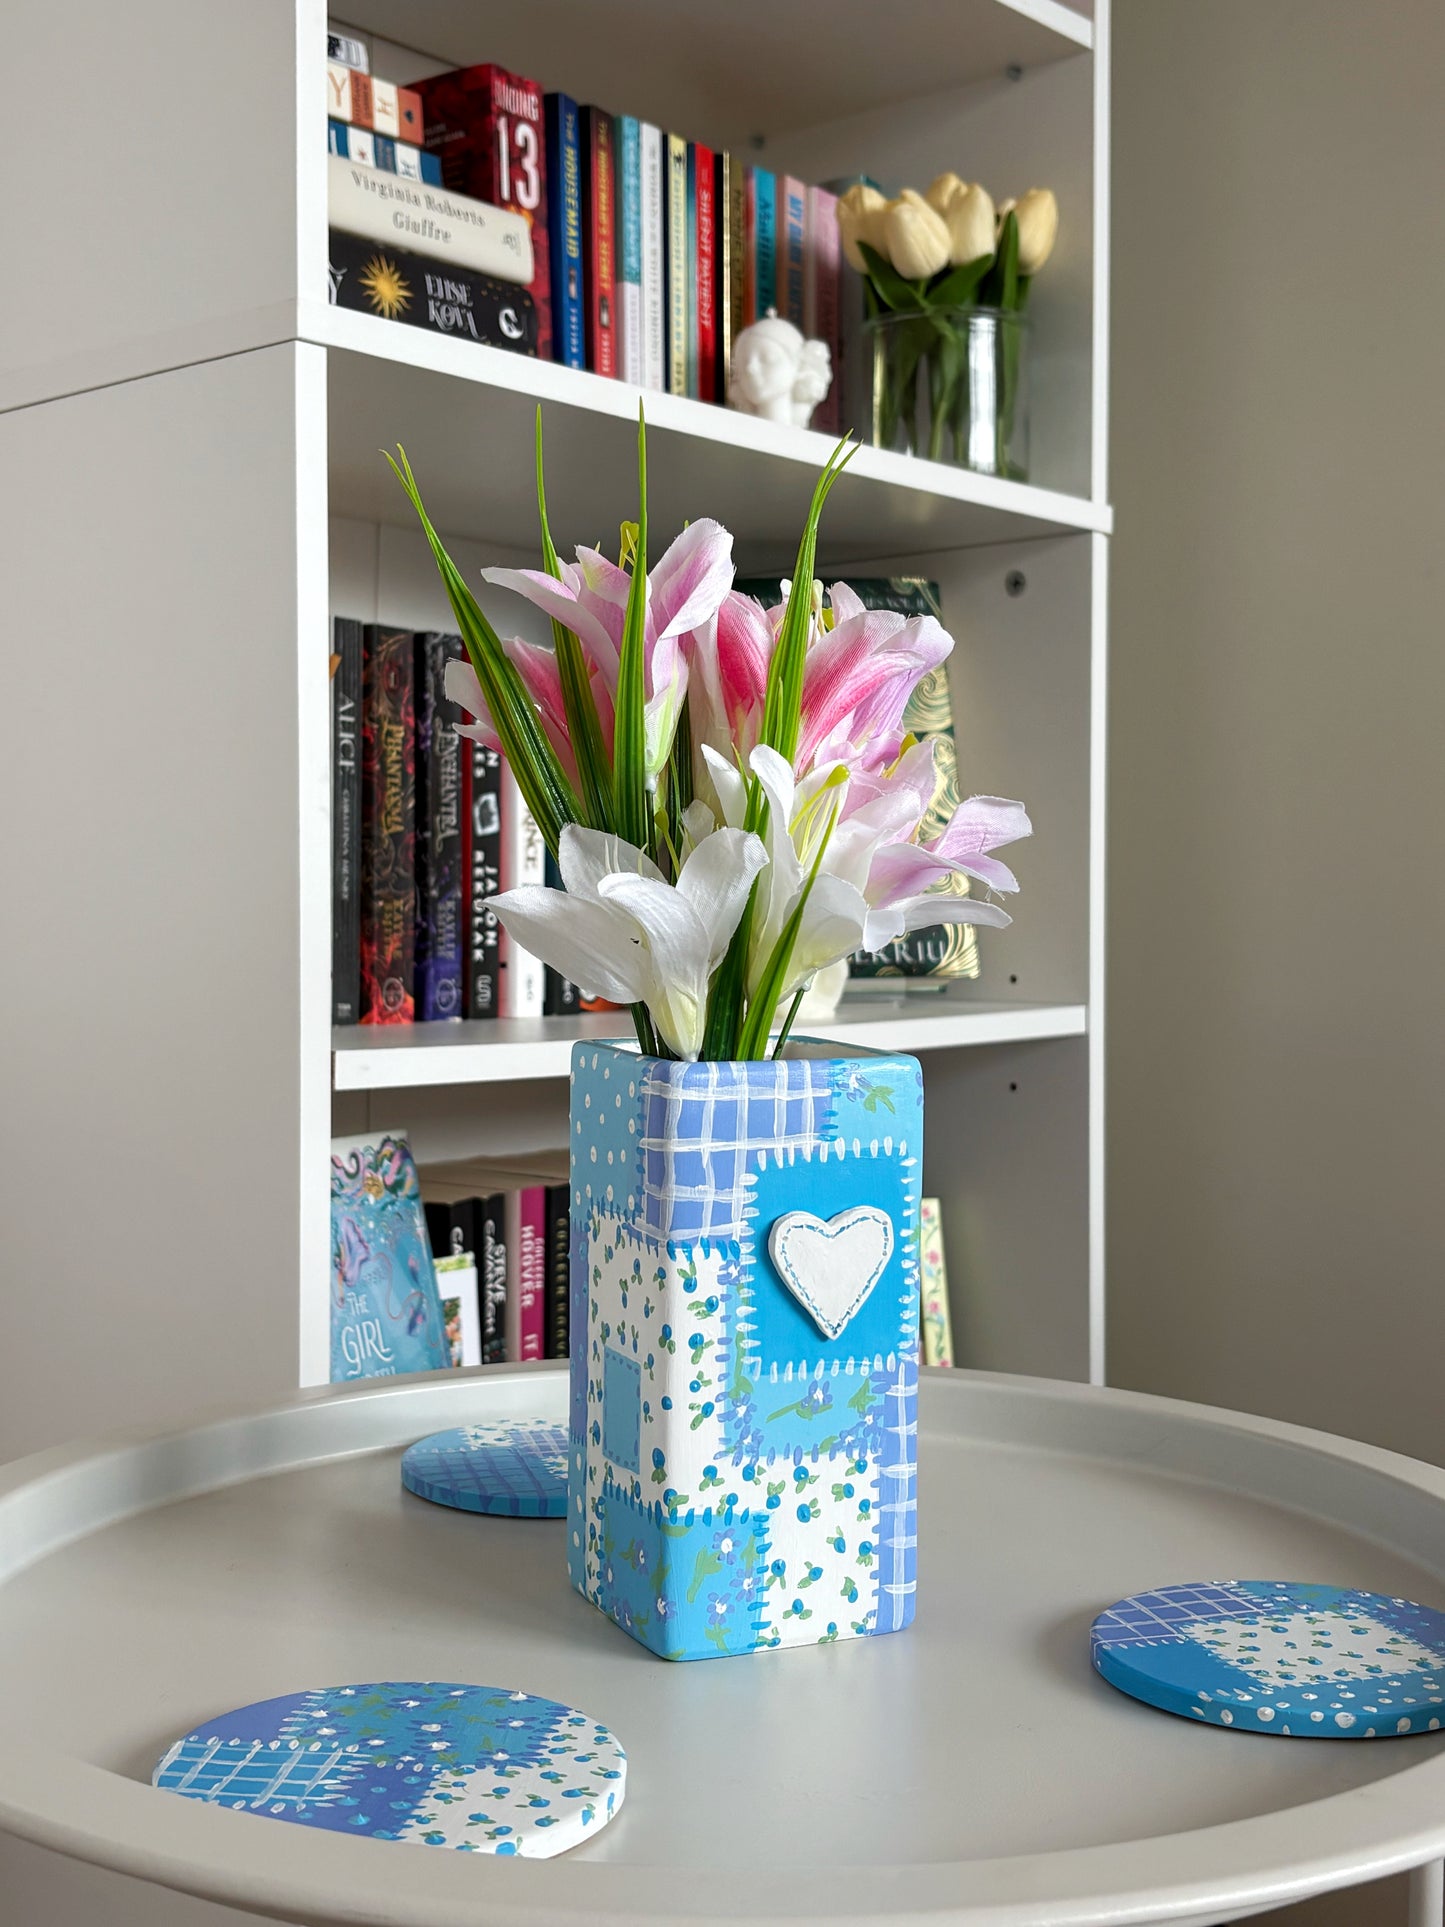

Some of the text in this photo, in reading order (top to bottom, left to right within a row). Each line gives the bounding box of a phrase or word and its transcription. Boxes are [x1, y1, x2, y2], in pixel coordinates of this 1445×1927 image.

[351, 169, 487, 228] Virginia Roberts
[496, 116, 541, 210] 13
[564, 145, 579, 259] HOUSEMAID
[392, 210, 452, 244] Giuffre
[699, 188, 713, 330] SILENT PATIENT
[339, 692, 357, 776] ALICE
[381, 719, 407, 840] PHANTASMA
[434, 721, 461, 852] ENCHANTRA
[485, 864, 498, 948] JAON
[346, 1292, 368, 1316] THE
[484, 1219, 496, 1336] CAVANAGH
[494, 1243, 507, 1305] STEVE
[521, 1225, 536, 1310] HOOVER
[534, 1237, 545, 1292] COLLEEN
[341, 1317, 395, 1378] GIRL
